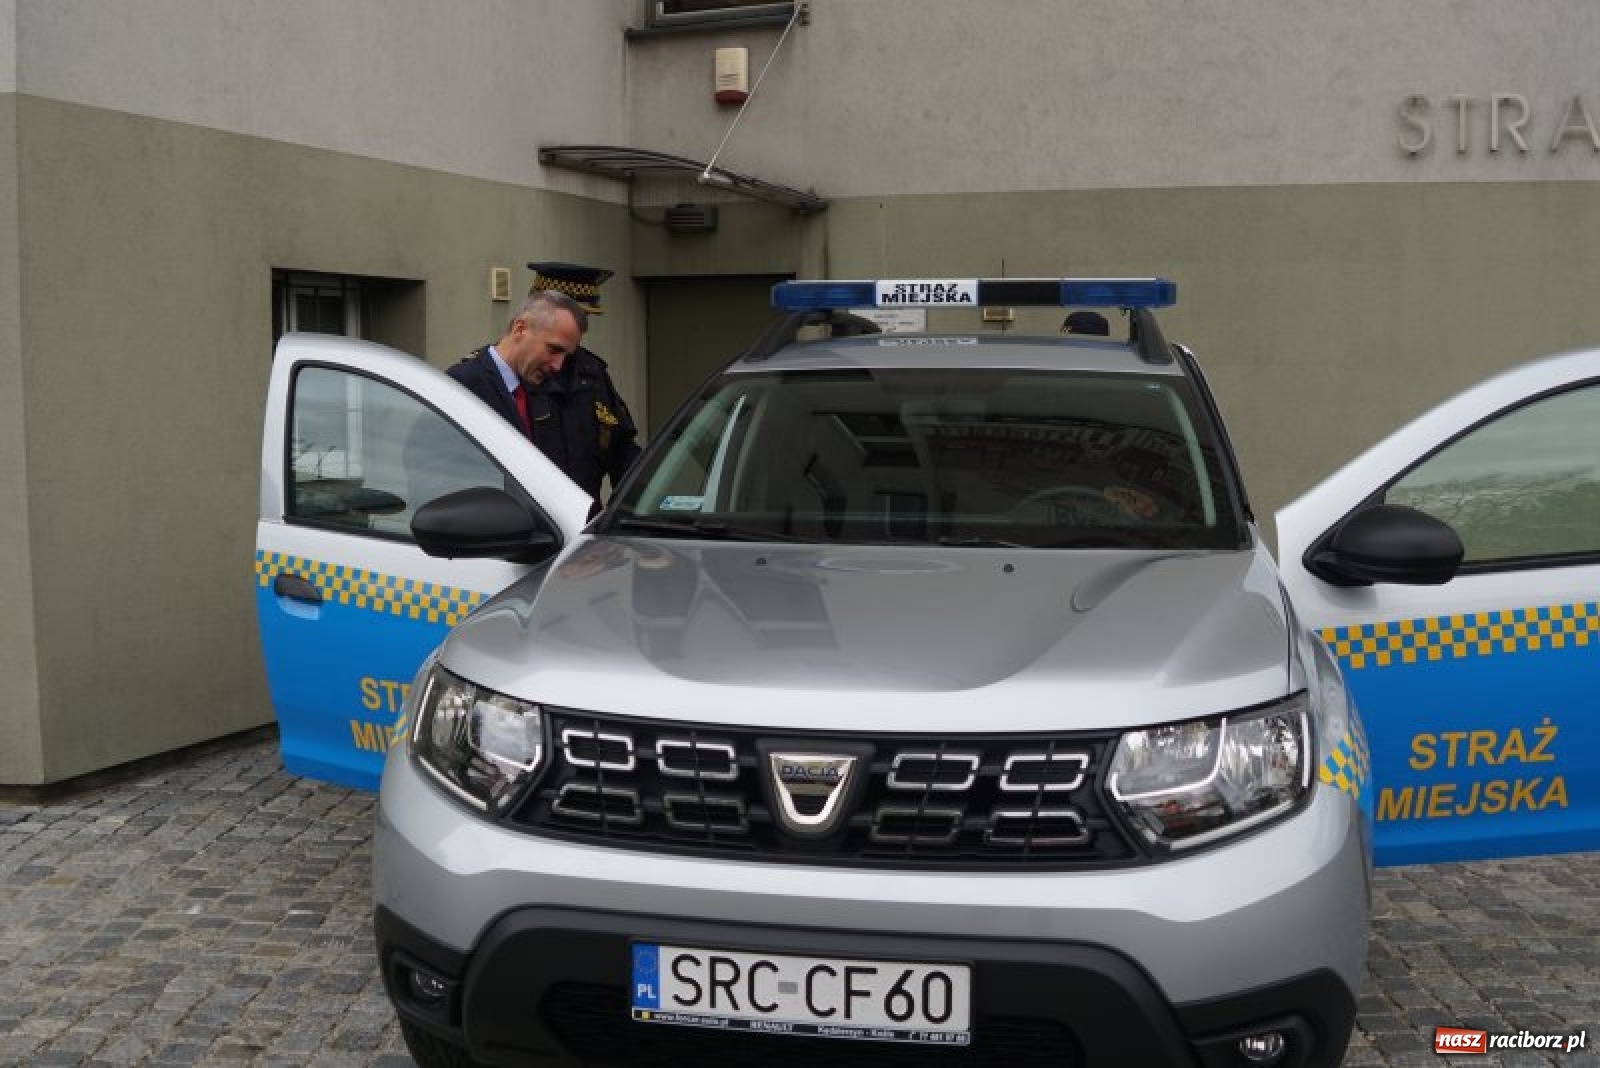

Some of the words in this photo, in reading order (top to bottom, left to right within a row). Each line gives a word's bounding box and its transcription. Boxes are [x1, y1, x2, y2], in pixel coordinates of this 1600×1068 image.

[1398, 93, 1600, 155] STRA
[881, 292, 972, 303] MIEJSKA
[1409, 717, 1558, 770] STRAŻ
[781, 766, 839, 778] DACIA
[1375, 776, 1568, 821] MIEJSKA
[637, 983, 656, 999] PL
